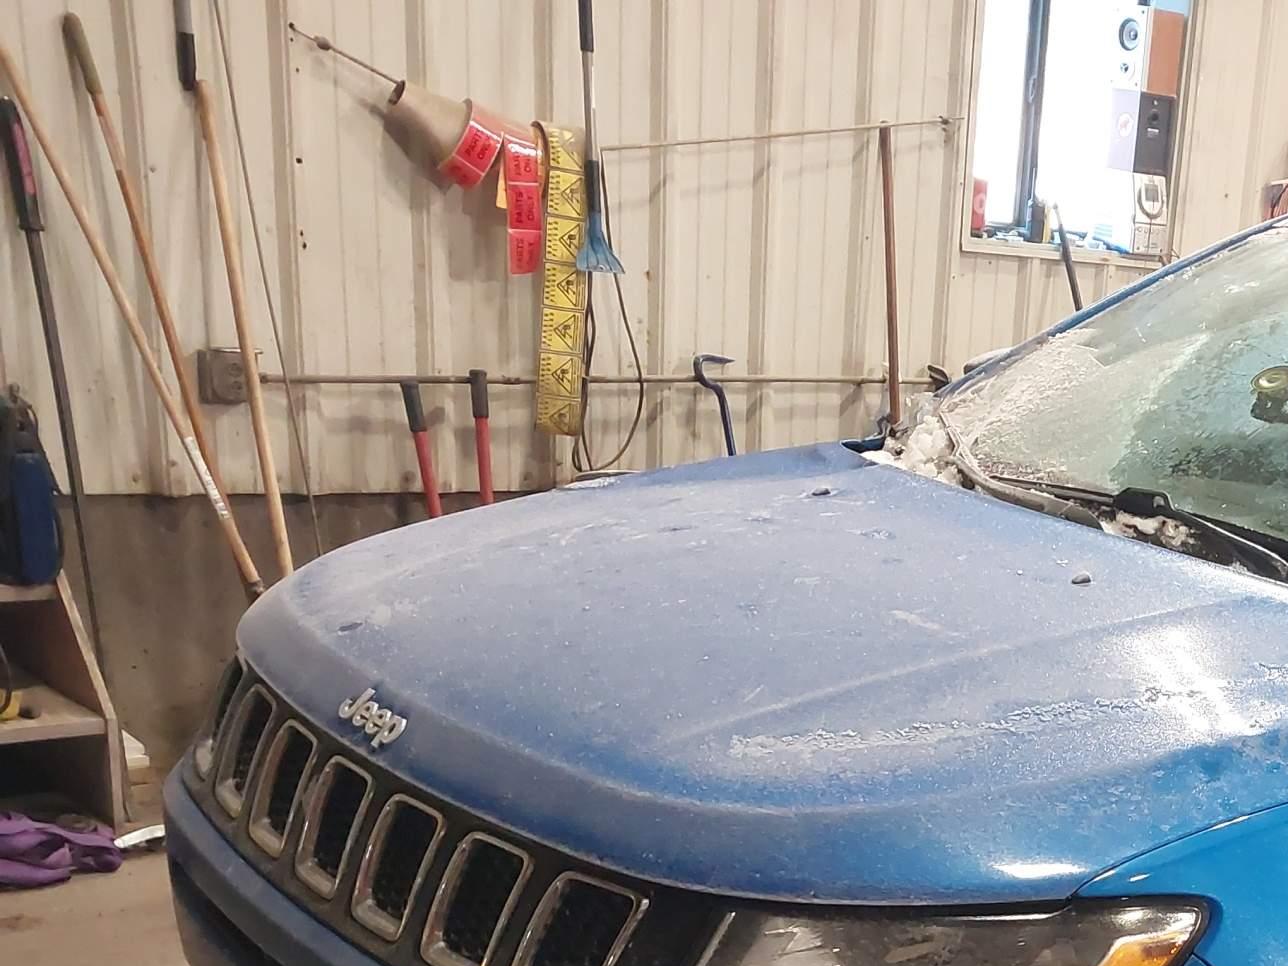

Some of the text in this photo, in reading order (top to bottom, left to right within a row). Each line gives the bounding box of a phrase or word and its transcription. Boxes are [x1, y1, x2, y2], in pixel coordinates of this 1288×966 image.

[514, 191, 523, 223] PARTS
[526, 196, 535, 221] ONLY
[338, 688, 408, 749] Jeep
